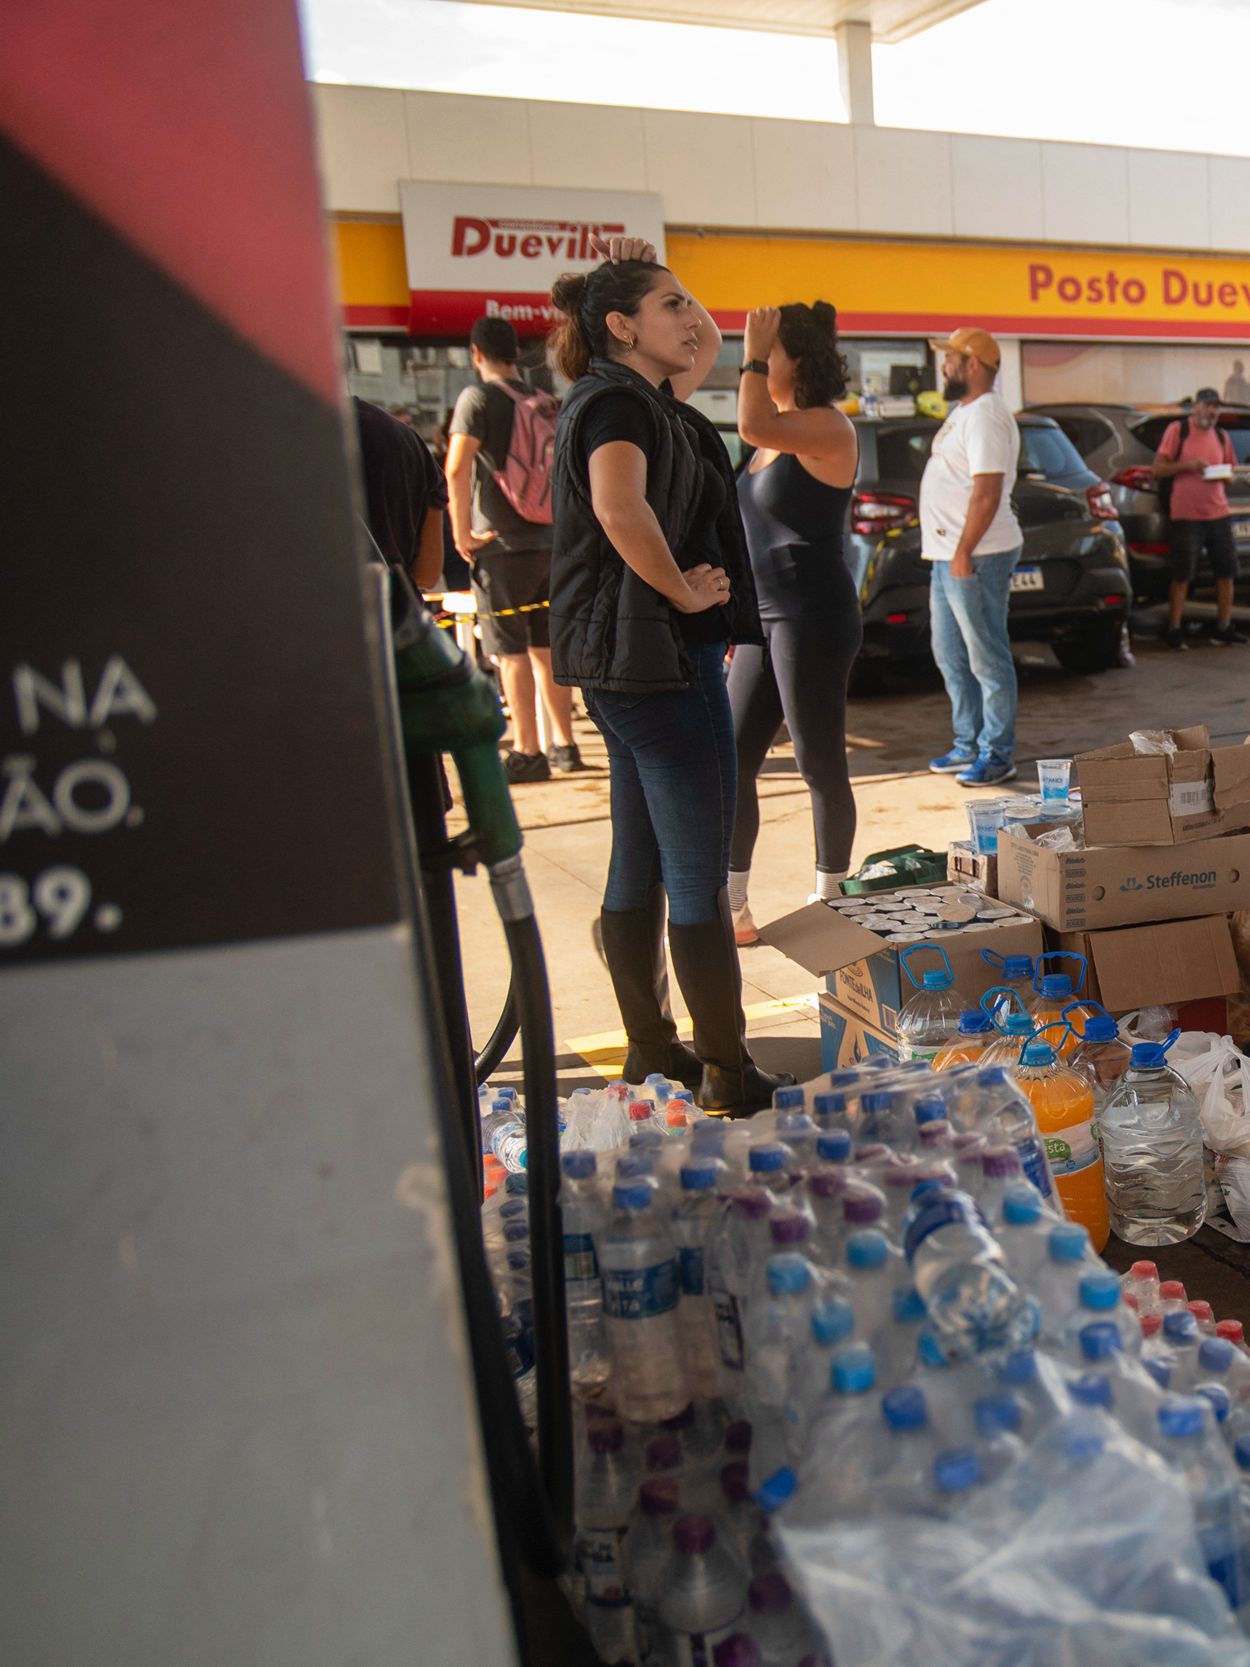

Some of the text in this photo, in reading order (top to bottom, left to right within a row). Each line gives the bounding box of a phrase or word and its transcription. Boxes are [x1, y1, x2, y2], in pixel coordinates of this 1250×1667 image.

[452, 215, 612, 260] Duevill
[1028, 263, 1147, 305] Posto
[12, 653, 158, 733] NA
[1146, 869, 1217, 891] Steffenon
